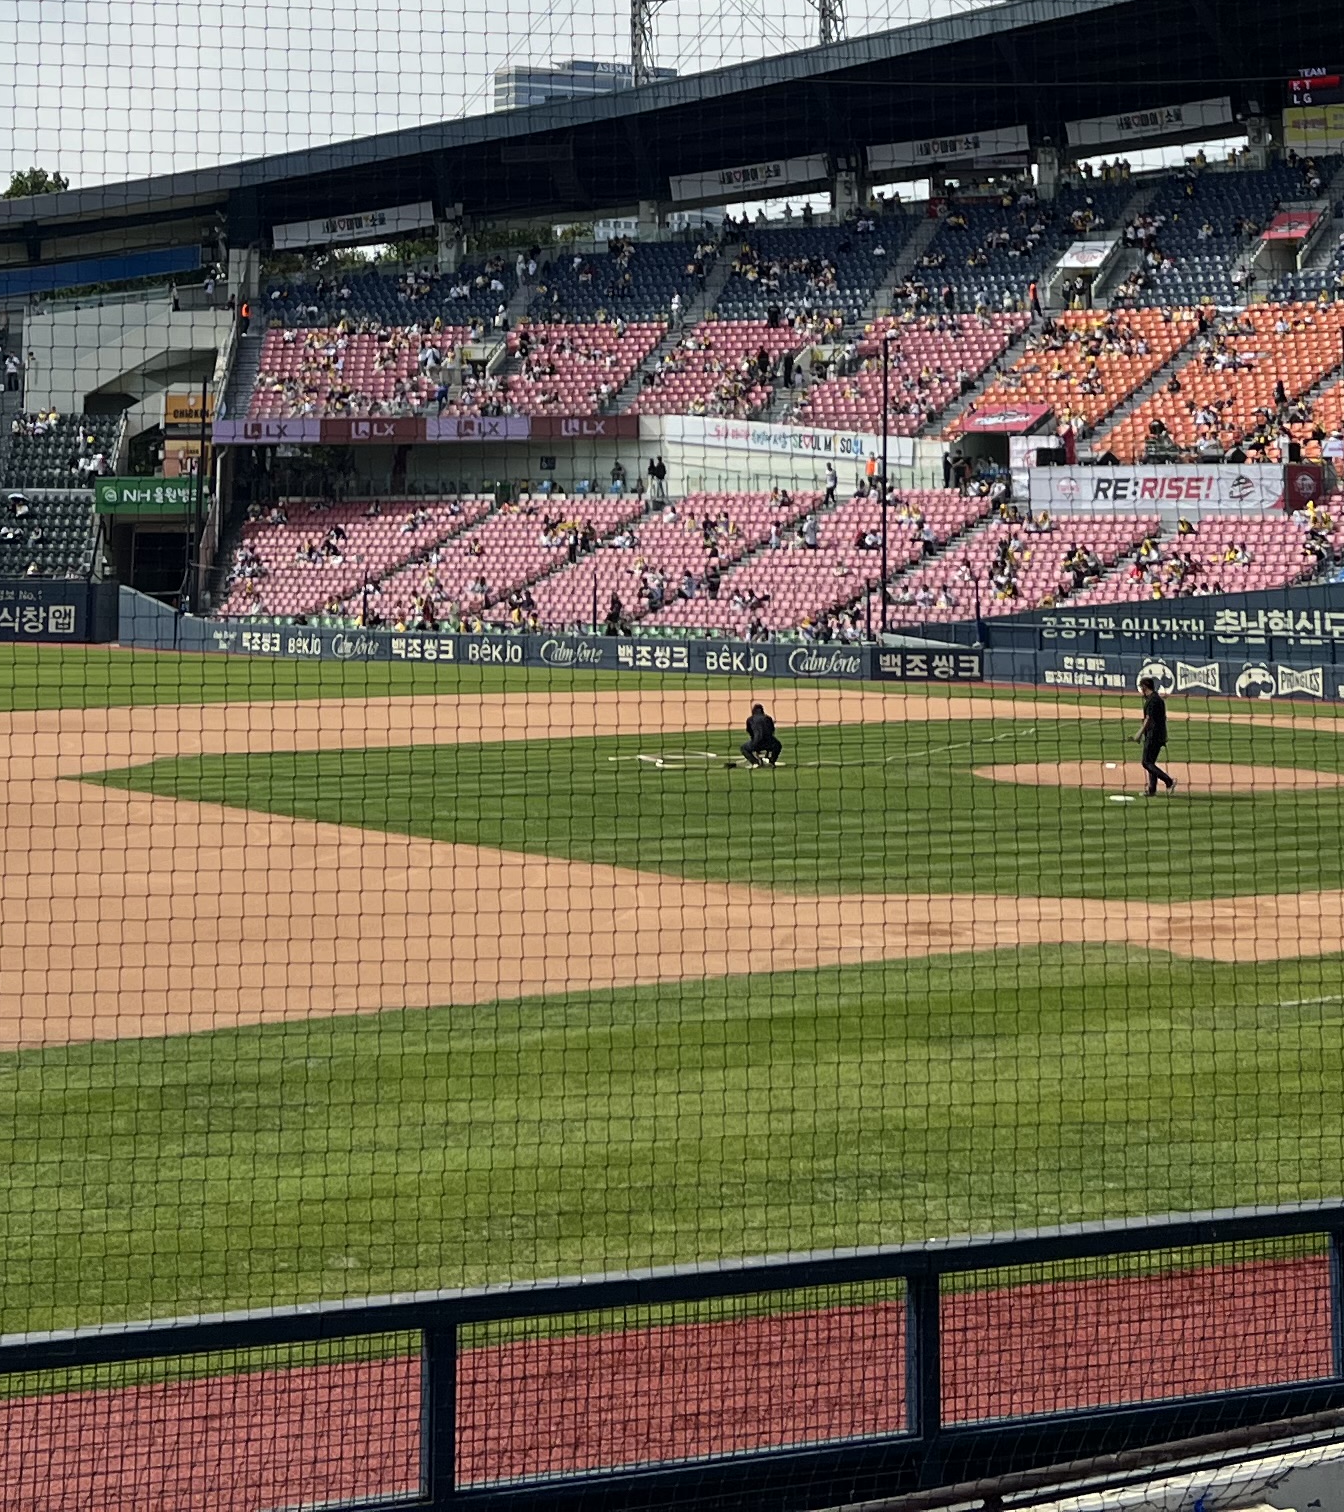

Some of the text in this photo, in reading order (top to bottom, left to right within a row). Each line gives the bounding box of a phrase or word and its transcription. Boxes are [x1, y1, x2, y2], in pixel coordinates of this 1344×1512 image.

[596, 63, 623, 73] ASEM
[1298, 68, 1327, 78] TEAM
[265, 424, 289, 439] LX
[373, 422, 395, 437] LX
[478, 420, 501, 436] LX
[582, 420, 606, 435] LX
[123, 489, 151, 502] NH
[1092, 476, 1213, 500] RE:RISE!
[391, 637, 454, 660] 백조씽크
[617, 643, 689, 669] 백조씽크
[879, 653, 982, 680] 백조씽크
[1179, 664, 1218, 690] PRINGLES
[1280, 668, 1320, 695] PRINGLES
